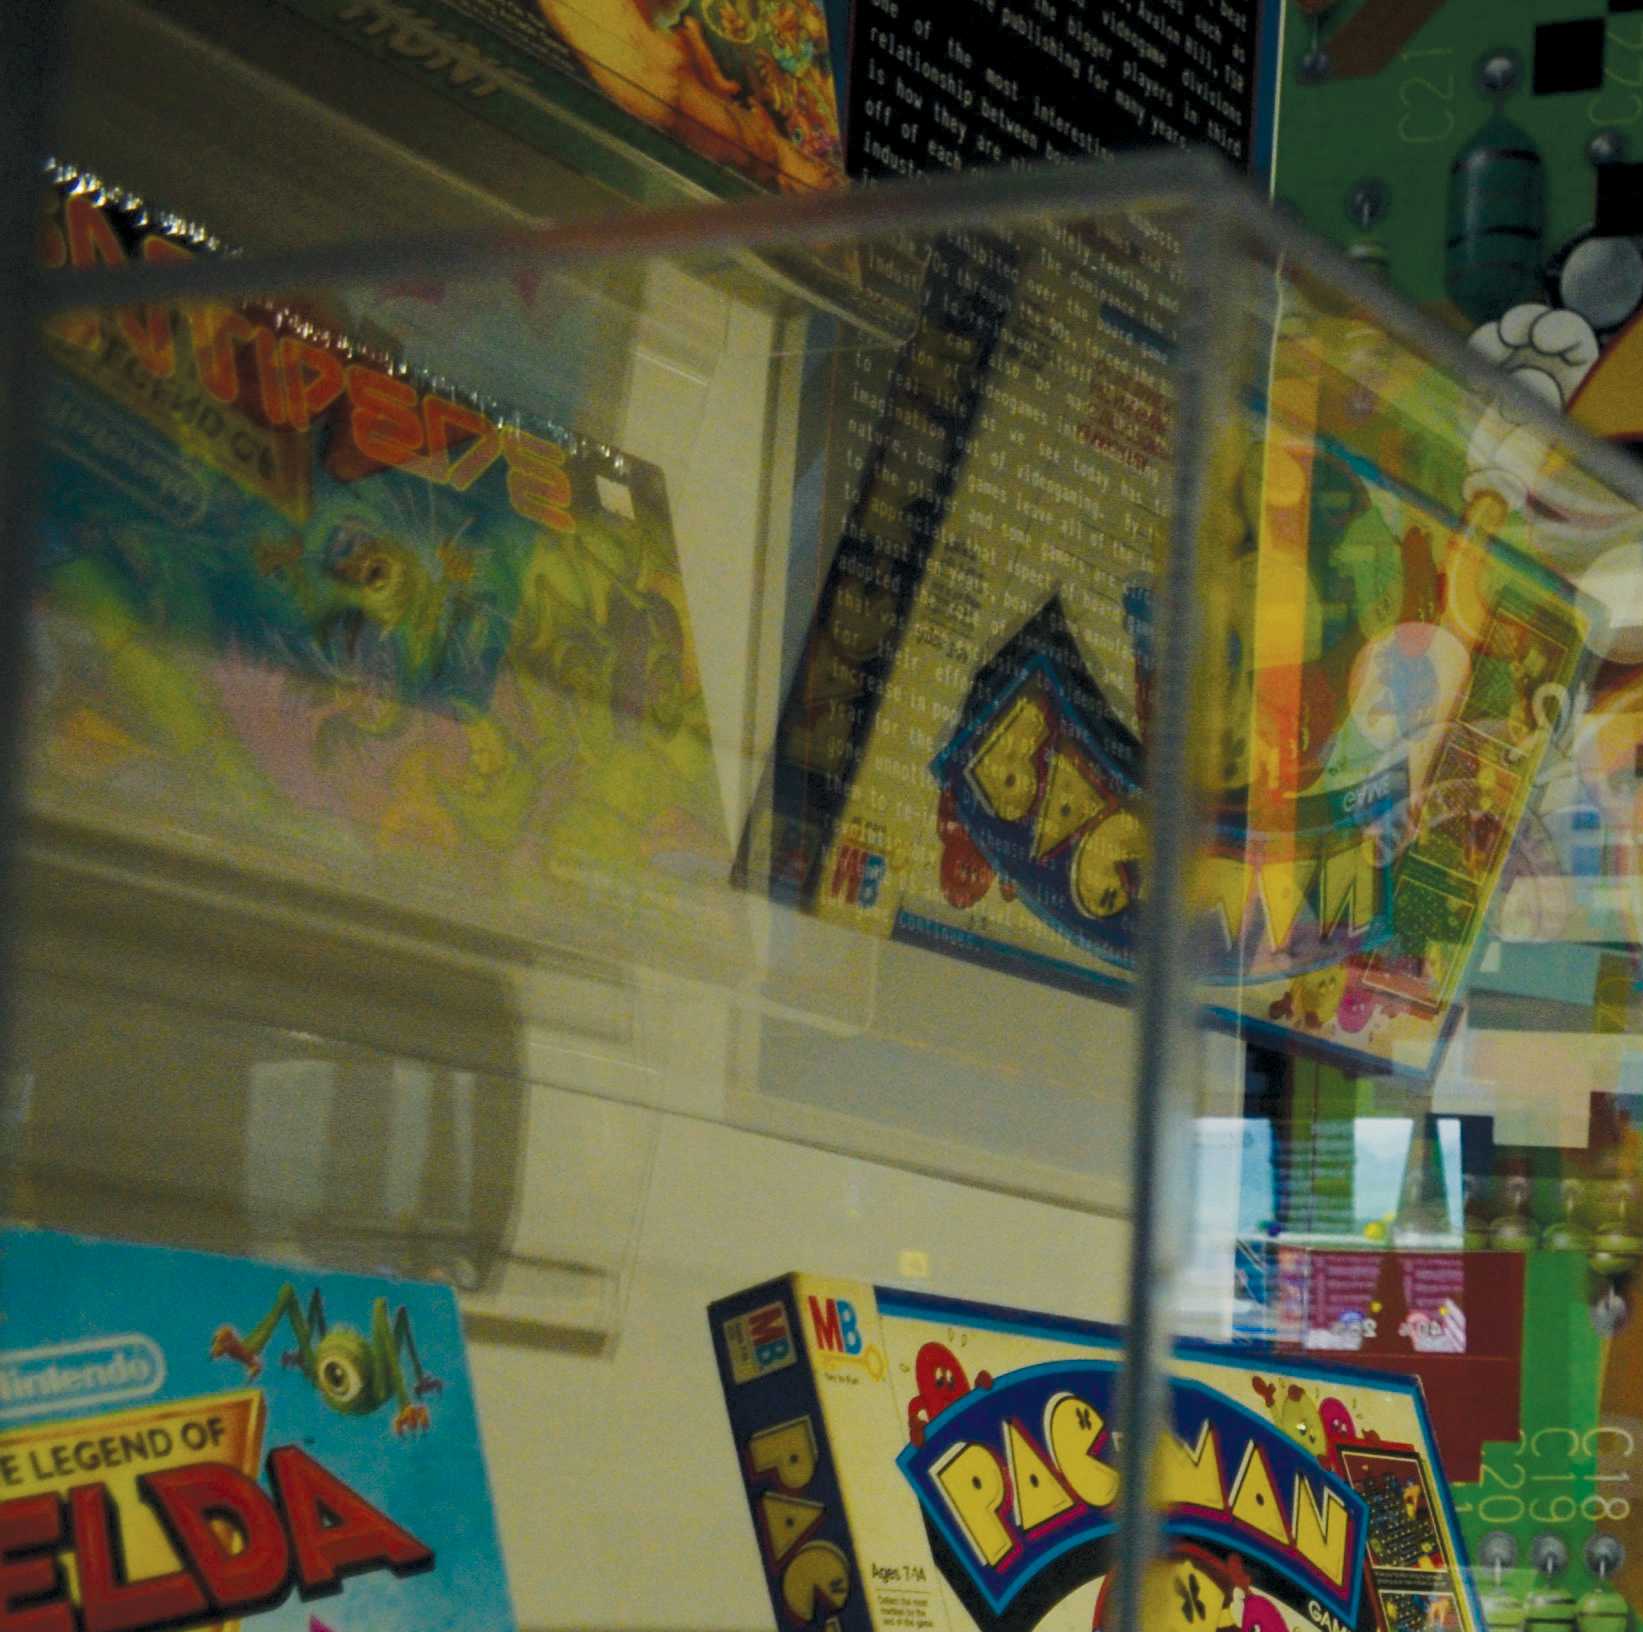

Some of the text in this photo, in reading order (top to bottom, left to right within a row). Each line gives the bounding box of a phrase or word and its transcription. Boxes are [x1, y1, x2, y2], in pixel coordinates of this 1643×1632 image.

[867, 54, 886, 90] is
[895, 72, 923, 113] how
[932, 98, 966, 146] they
[869, 22, 1038, 150] relationship between
[946, 31, 973, 68] the
[984, 62, 1018, 105] most
[1120, 53, 1173, 108] players
[1399, 47, 1455, 146] C21
[863, 88, 891, 128] off
[899, 113, 919, 146] of
[748, 1303, 793, 1366] MB
[807, 1296, 863, 1354] MB
[0, 1350, 152, 1398] intendo
[32, 1427, 173, 1482] LEGEND
[180, 1417, 226, 1451] OF
[1529, 1427, 1582, 1523] C19
[1581, 1426, 1635, 1521] C18
[872, 1564, 900, 1583] Ages
